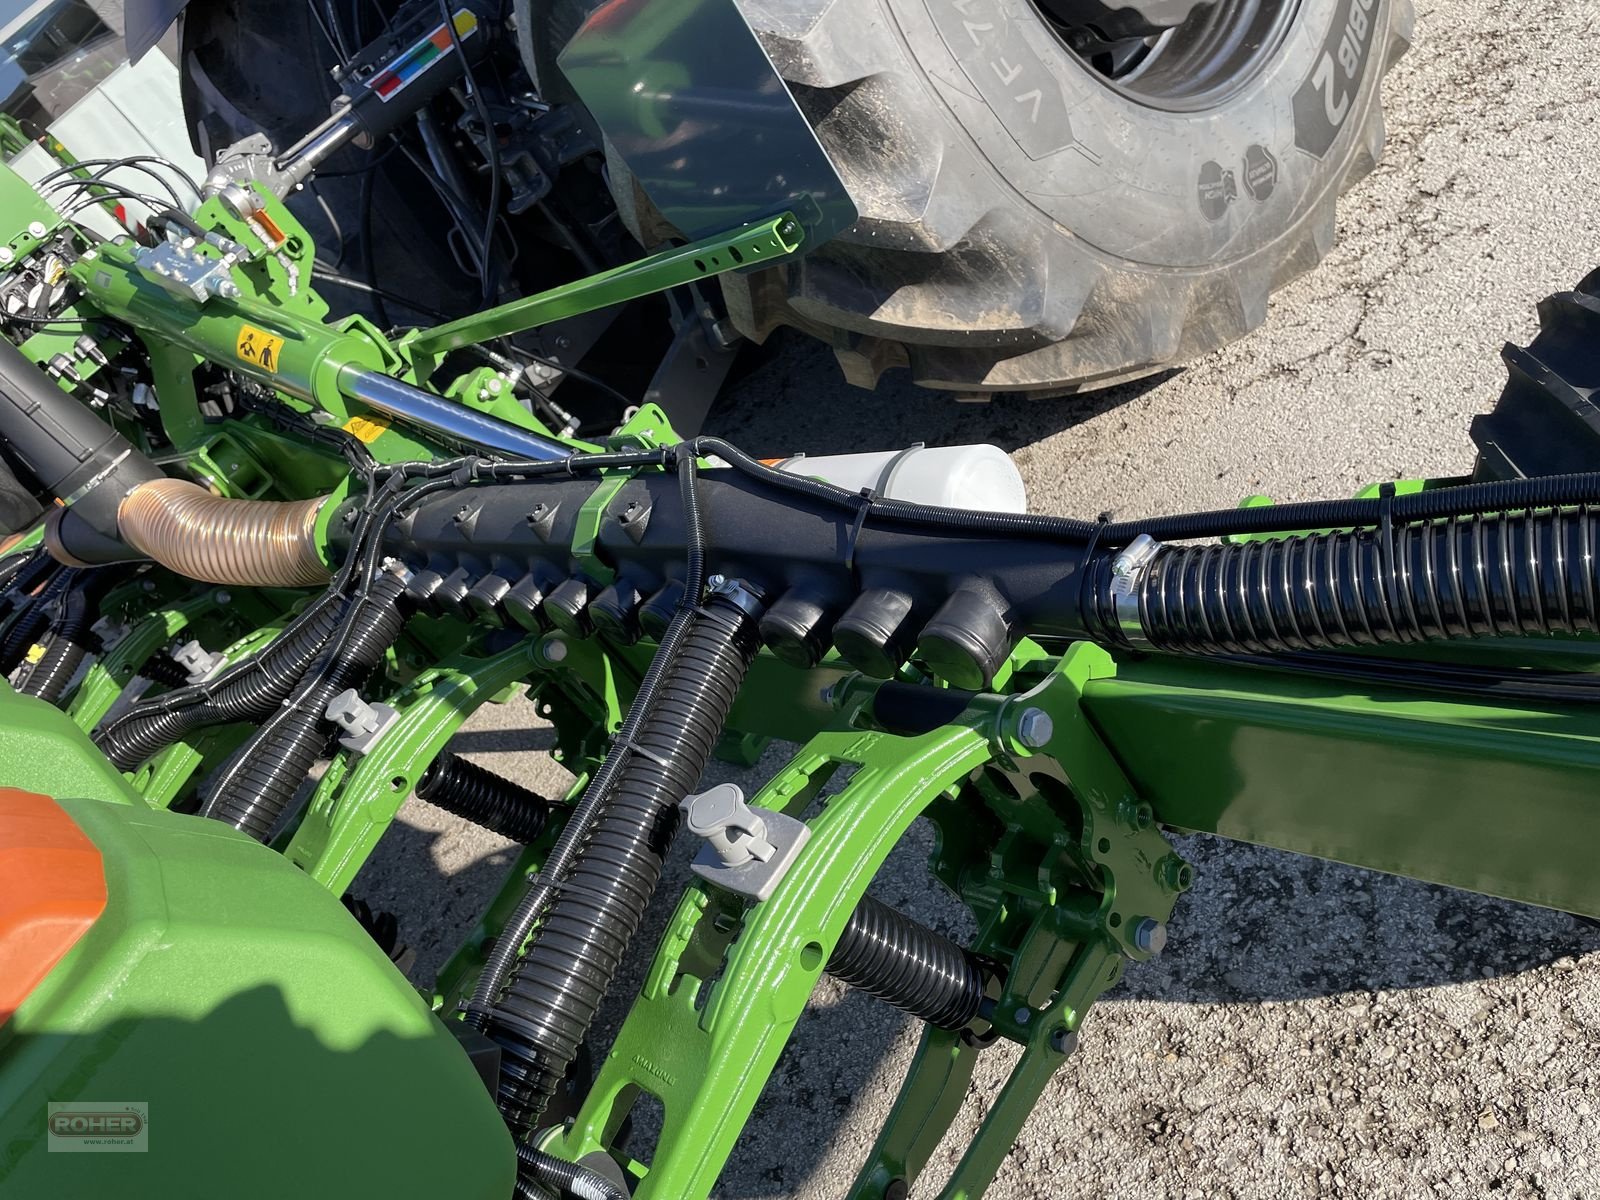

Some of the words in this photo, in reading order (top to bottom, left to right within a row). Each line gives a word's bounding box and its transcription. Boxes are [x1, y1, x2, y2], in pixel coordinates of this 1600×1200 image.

[1337, 0, 1374, 79] BIB
[989, 56, 1043, 124] VF
[1311, 50, 1350, 127] 2
